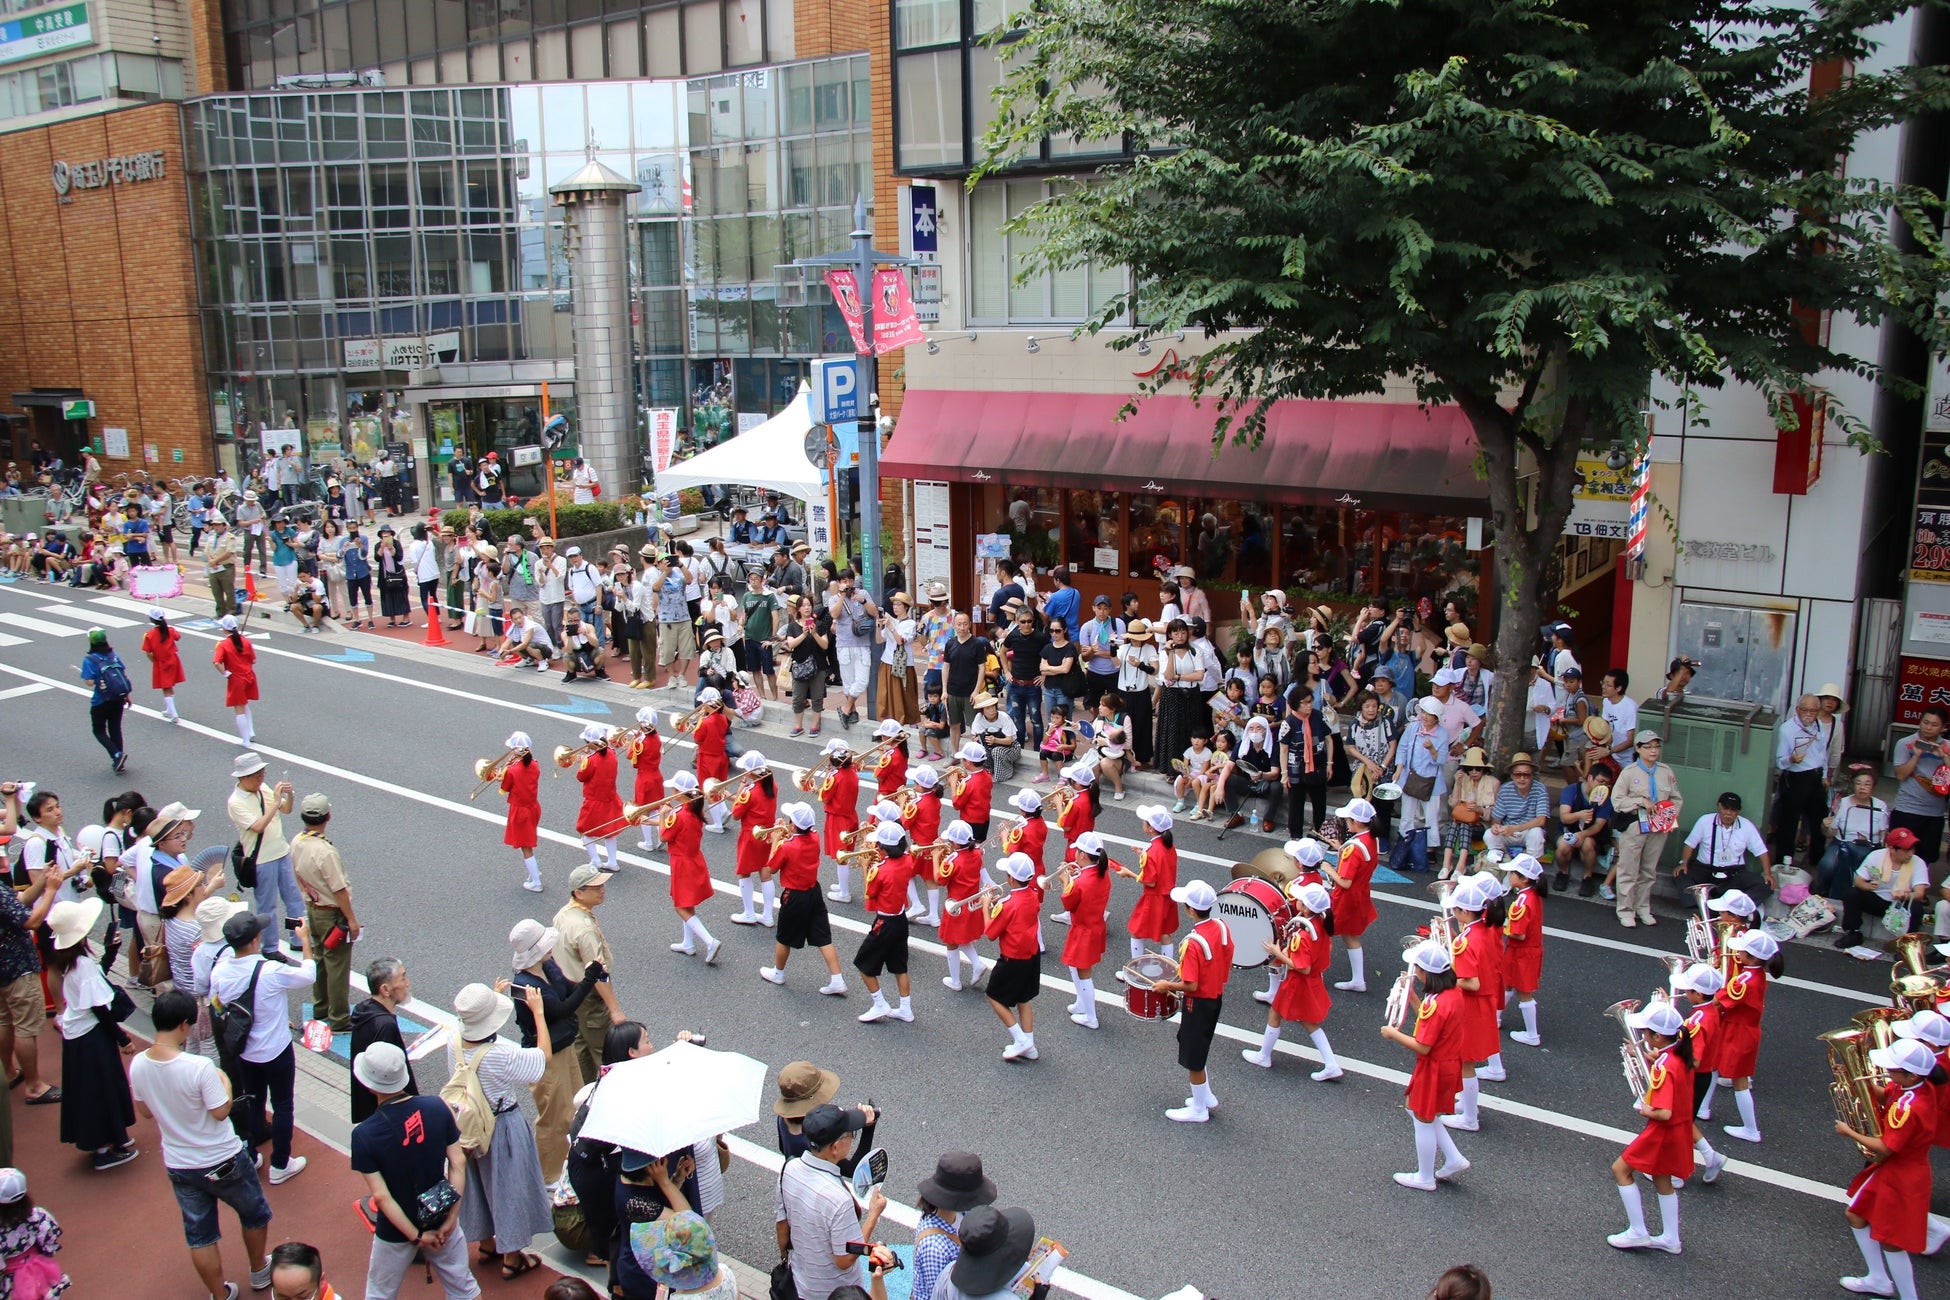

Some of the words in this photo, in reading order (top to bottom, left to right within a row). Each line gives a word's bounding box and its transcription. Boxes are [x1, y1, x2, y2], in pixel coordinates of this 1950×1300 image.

[72, 150, 166, 190] 埼玉りそな銀行
[914, 203, 935, 237] 本
[827, 366, 856, 410] P
[1685, 540, 1776, 562] 文教堂ビル
[1218, 902, 1258, 919] YAMAHA
